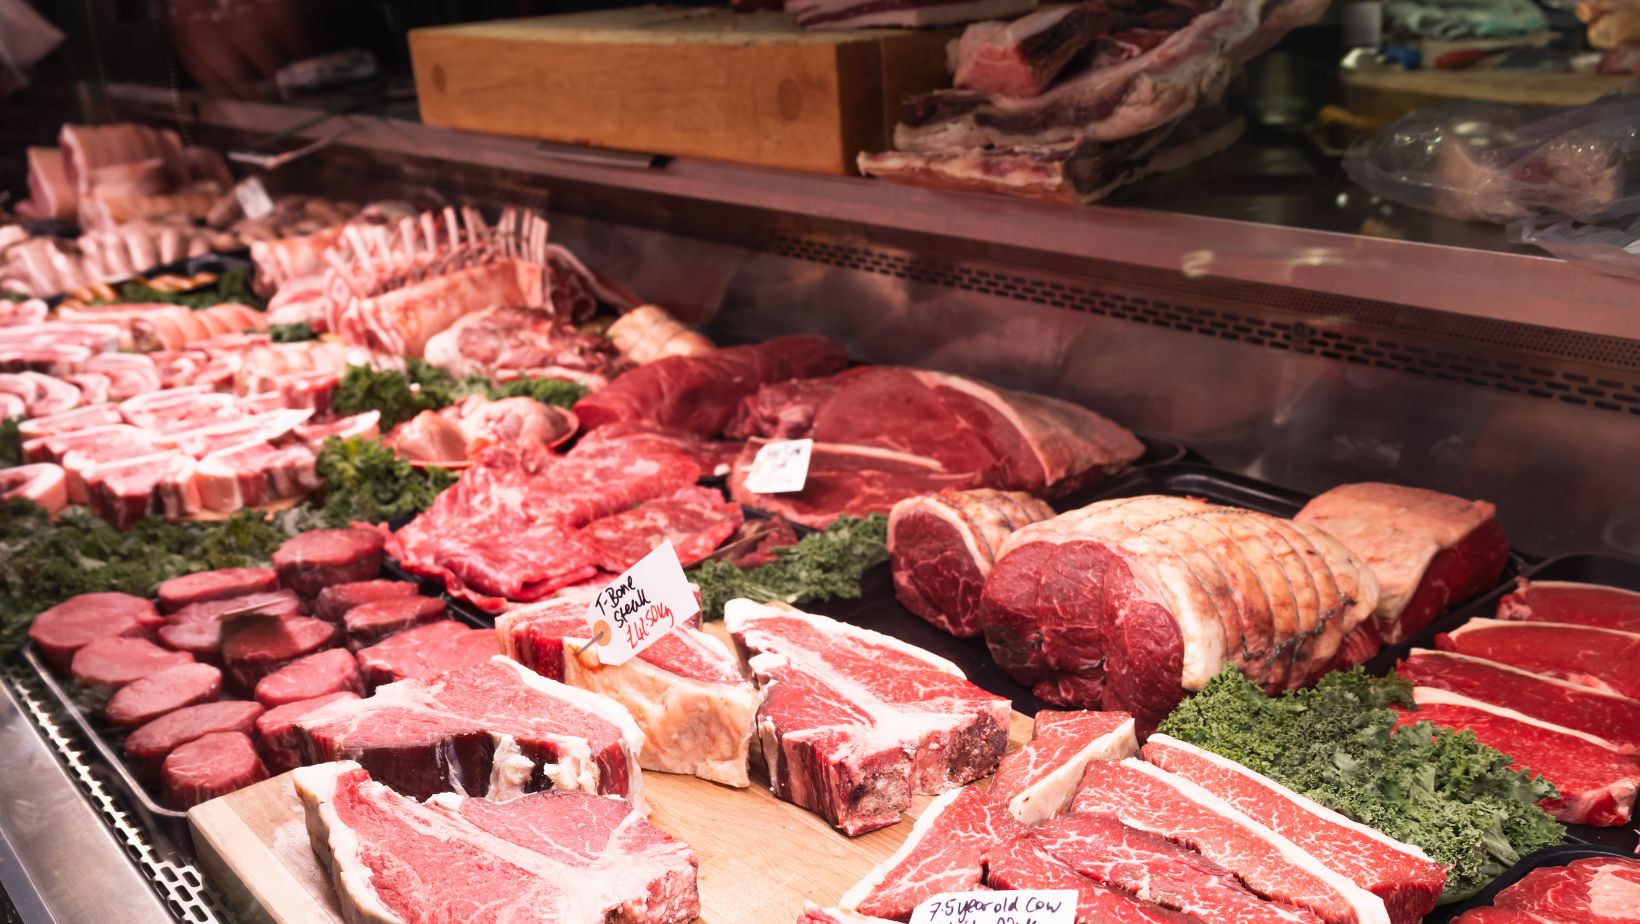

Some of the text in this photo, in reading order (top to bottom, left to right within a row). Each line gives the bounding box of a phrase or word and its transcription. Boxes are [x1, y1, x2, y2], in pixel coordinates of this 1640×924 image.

[595, 575, 636, 616] T-Bone
[930, 898, 957, 922] 7.5
[957, 899, 994, 924] year
[994, 896, 1019, 913] old
